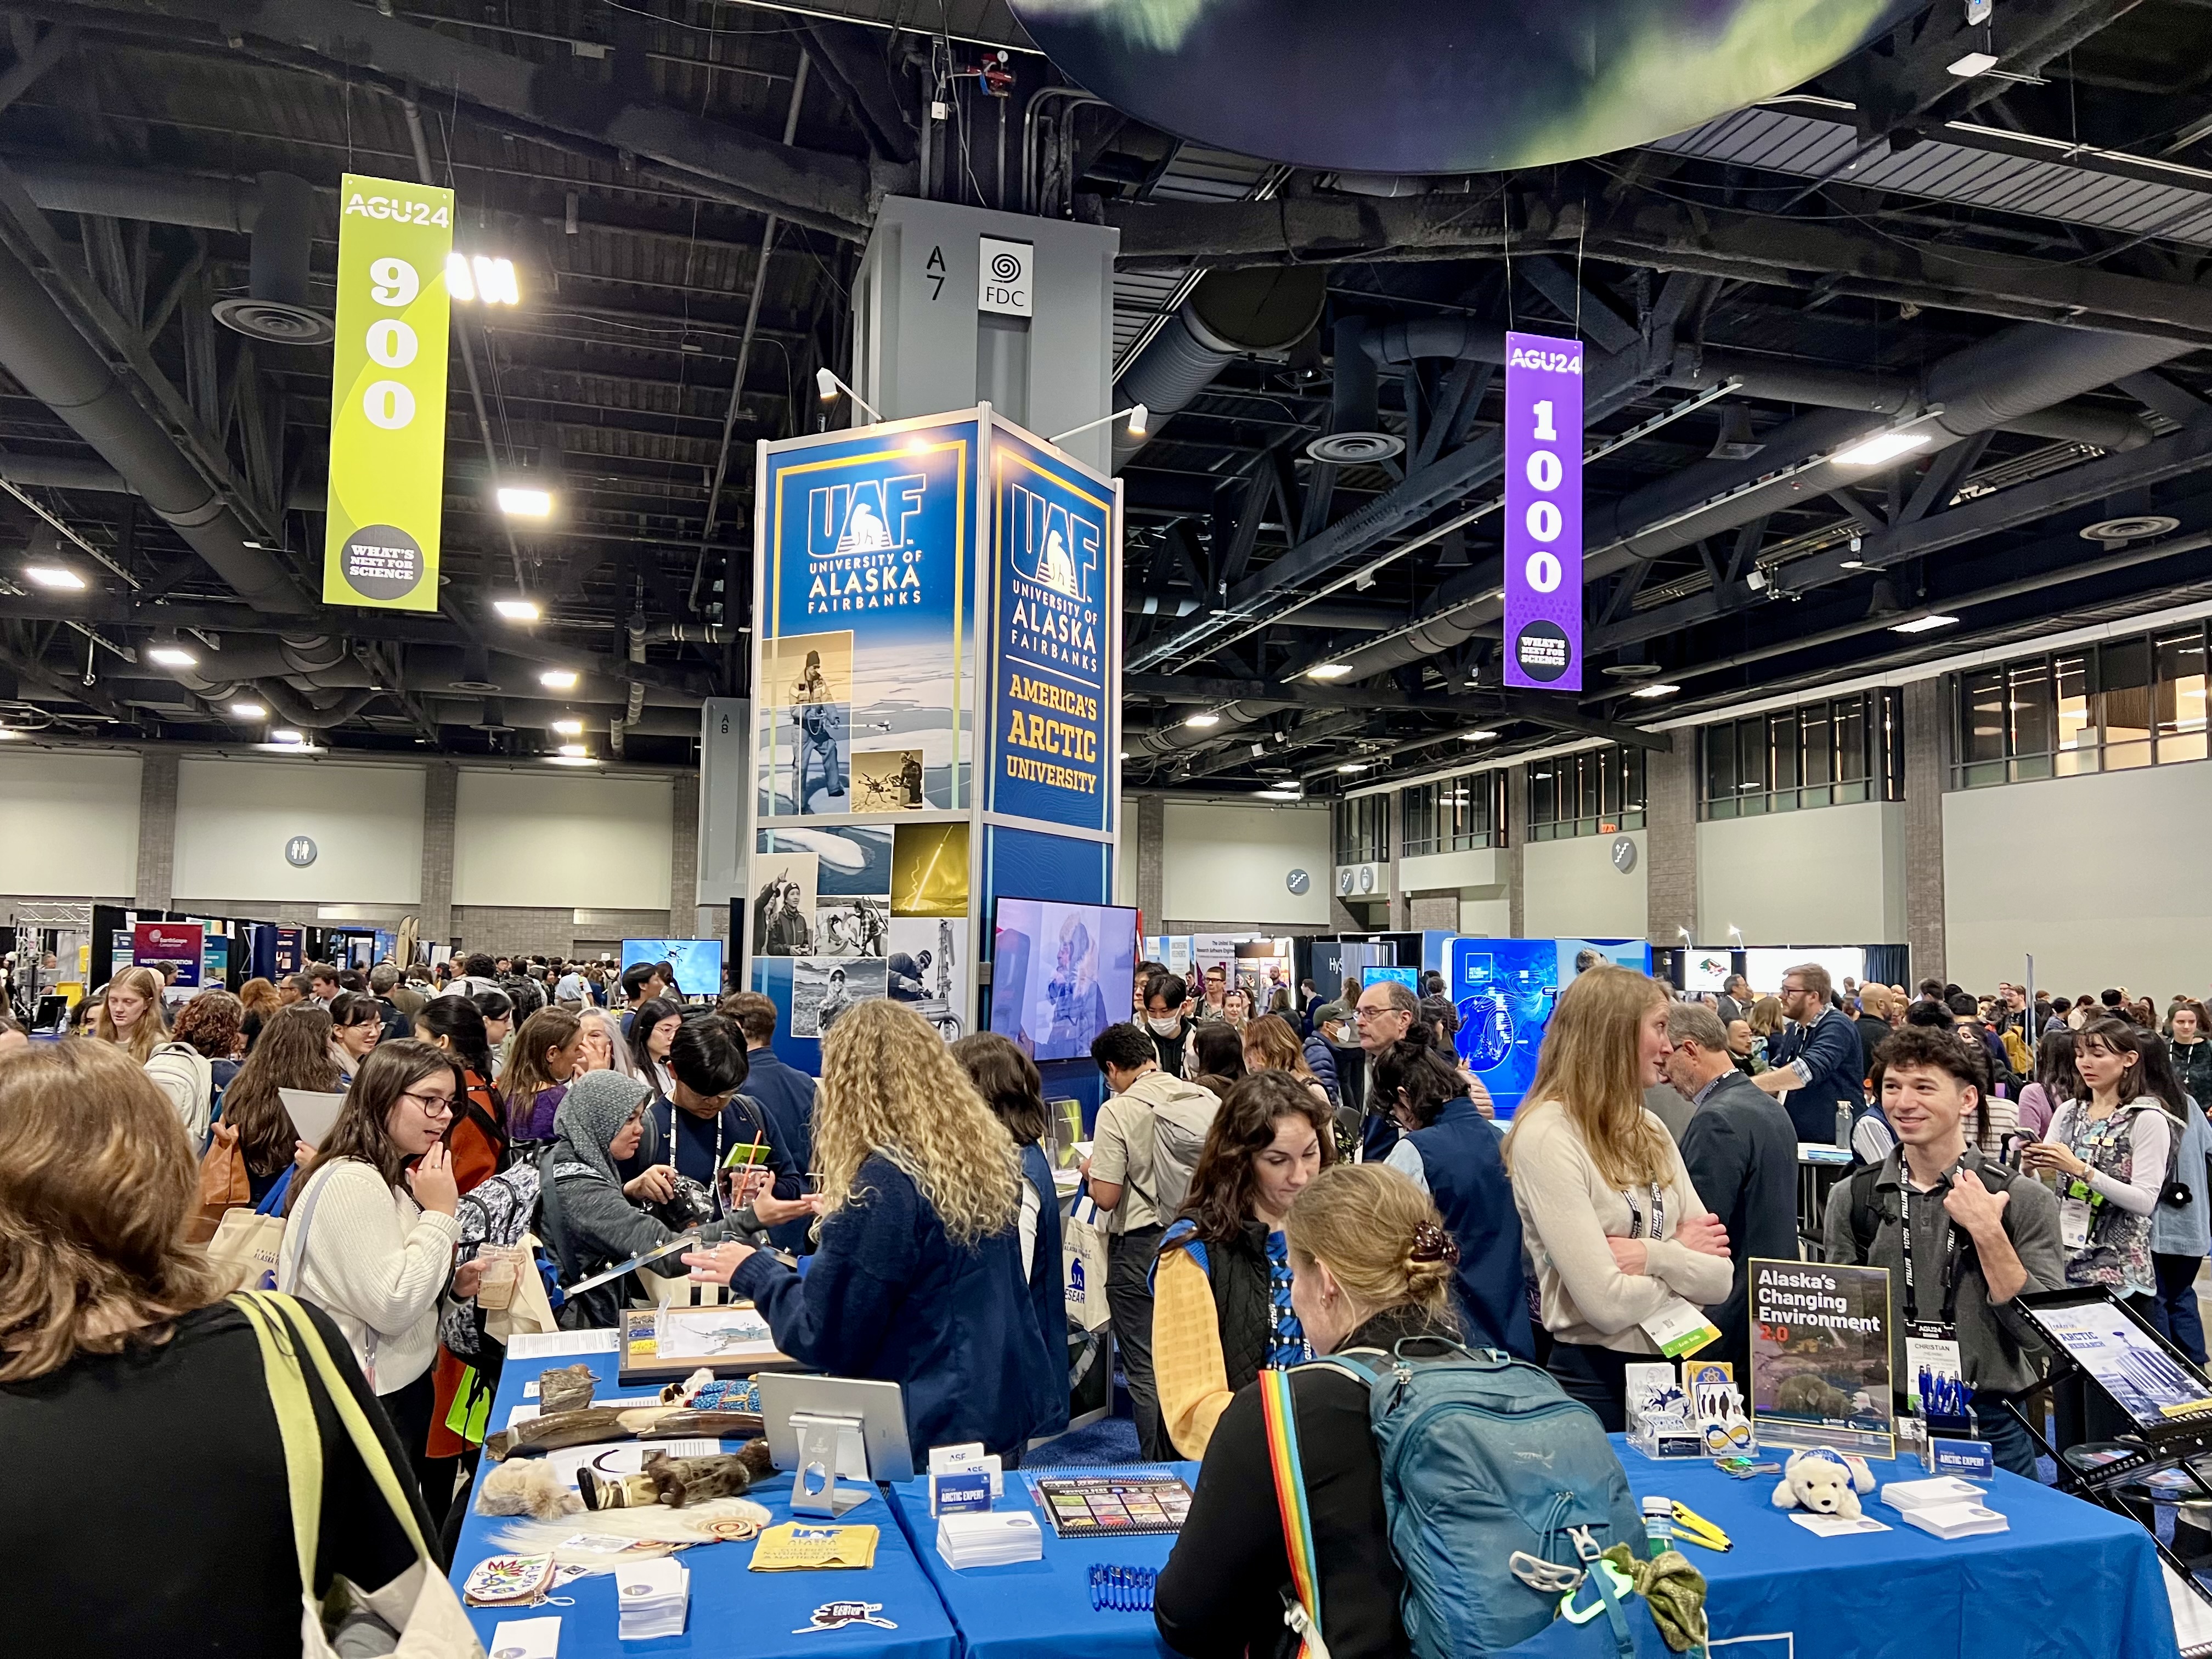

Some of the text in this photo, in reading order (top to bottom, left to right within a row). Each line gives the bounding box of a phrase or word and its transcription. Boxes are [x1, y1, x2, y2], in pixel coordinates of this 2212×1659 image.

[345, 194, 449, 228] AGU24
[986, 286, 1024, 307] FDC
[1510, 348, 1581, 375] AGU24
[808, 473, 926, 558] UAF
[351, 544, 415, 560] WHAT'S
[1011, 483, 1099, 602] UAF
[349, 566, 414, 580] SCIENCE
[350, 556, 414, 569] NEXT FOR
[809, 550, 922, 574] UNIVERSITY OF
[809, 564, 920, 599] ALASKA
[808, 590, 921, 614] FAIRBANKS
[1012, 579, 1097, 625] UNIVERSITY OF
[1011, 598, 1097, 655] ALASKA
[1011, 632, 1097, 673] FAIRBANKS
[1521, 654, 1565, 665] SCIENCE
[1008, 673, 1097, 720] AMERICA'S
[1007, 709, 1097, 763] ARCTIC
[1006, 754, 1097, 794] UNIVERSITY
[1758, 1269, 1836, 1290] Alaska's
[1758, 1288, 1847, 1313] Changing
[1759, 1306, 1881, 1333] Environment
[1760, 1324, 1789, 1342] 2.0
[2058, 1331, 2098, 1341] ARCTIC
[1914, 1343, 1950, 1352] CHRISTIAN
[1940, 1454, 1985, 1467] ARCTIC EXPERT
[941, 1492, 963, 1503] ARCTIC
[963, 1489, 984, 1501] EXPERT
[791, 1528, 843, 1539] UAF
